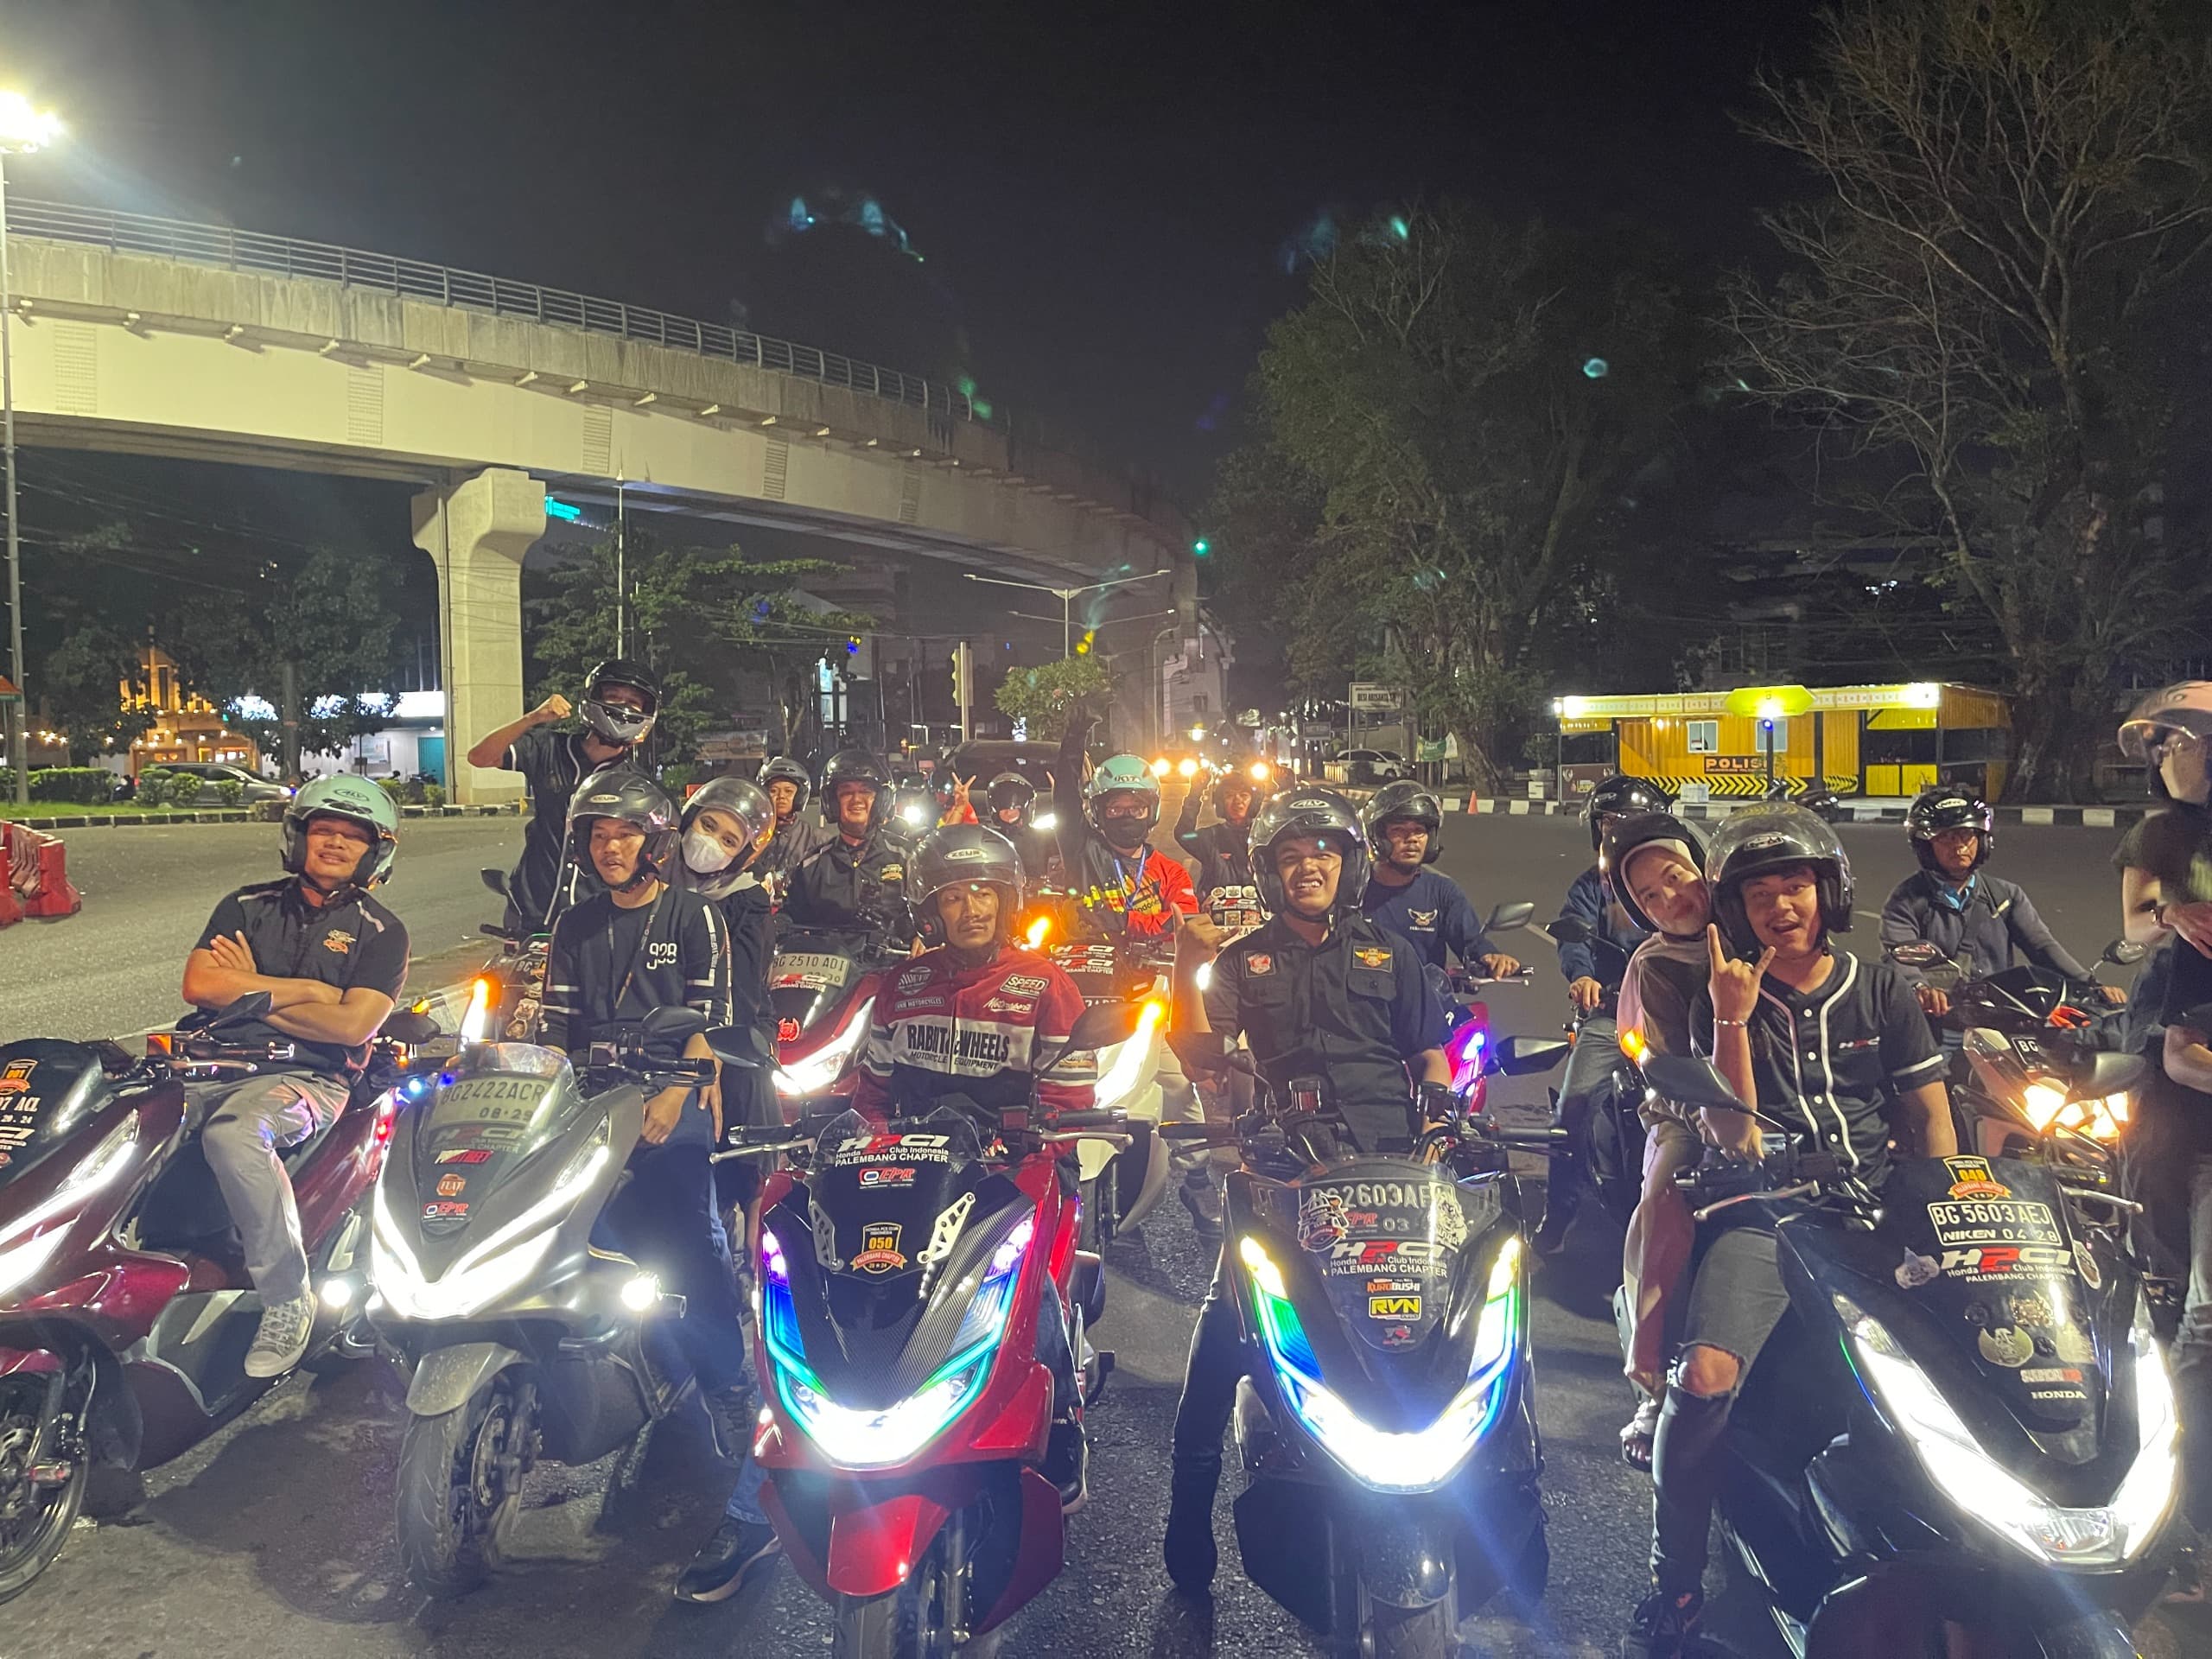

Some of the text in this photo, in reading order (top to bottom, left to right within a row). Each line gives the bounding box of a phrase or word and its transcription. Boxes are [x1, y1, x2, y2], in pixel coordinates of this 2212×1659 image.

[790, 956, 819, 968] 2510
[1007, 976, 1047, 991] SPEED
[959, 1030, 1010, 1063] WHEELS
[954, 1057, 999, 1071] EQUIPMENT
[837, 1134, 950, 1153] HPCI
[835, 1153, 949, 1167] PALEMBANG CHAPTER
[836, 1149, 861, 1160] Honda
[889, 1146, 908, 1154] Club
[909, 1146, 950, 1154] Indonesia
[1931, 1205, 1961, 1225] BG
[1961, 1204, 2016, 1224] 5603
[868, 1236, 893, 1249] 050
[1942, 1229, 1997, 1242] NIKEN
[1331, 1257, 1357, 1268] Honda
[1388, 1255, 1408, 1264] Club
[1331, 1263, 1448, 1277] PALEMBANG CHAPTER
[1948, 1266, 1979, 1278] Honda
[1966, 1273, 2025, 1283] PALEMBANG
[1371, 1298, 1420, 1314] RVN
[2031, 1390, 2088, 1400] HONDA
